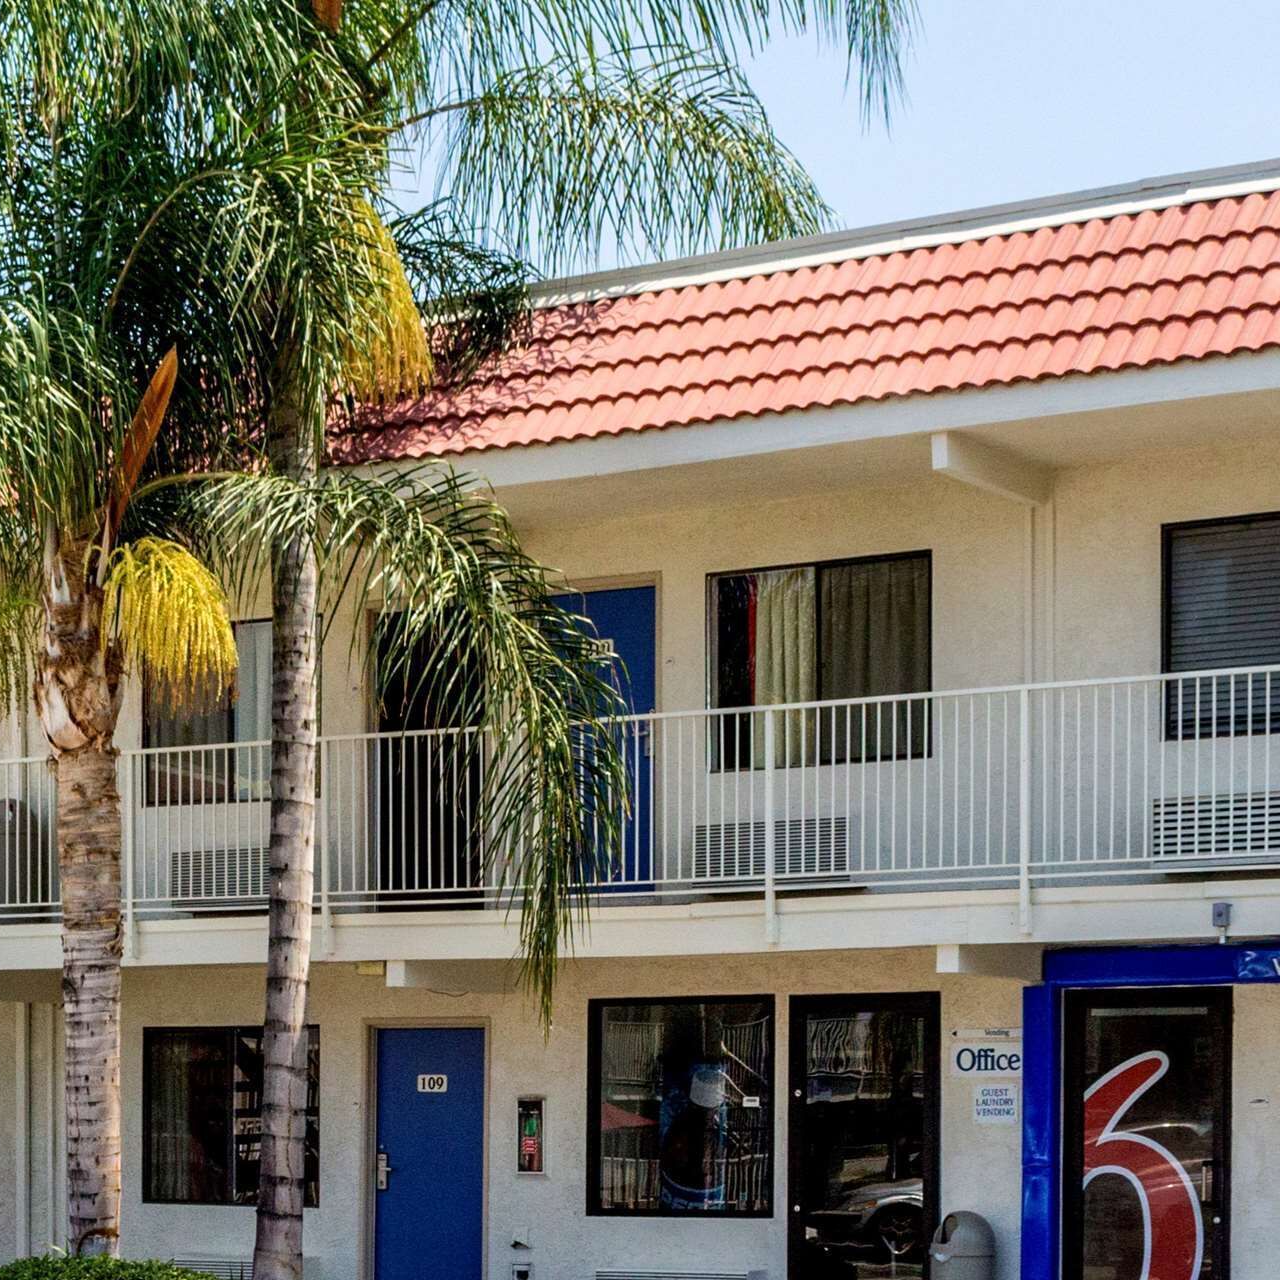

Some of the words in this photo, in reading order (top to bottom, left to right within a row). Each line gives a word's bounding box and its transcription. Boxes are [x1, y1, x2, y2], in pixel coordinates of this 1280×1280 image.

[956, 1047, 1021, 1072] Office
[421, 1076, 444, 1090] 109
[981, 1088, 1008, 1097] GUEST
[975, 1098, 1014, 1107] LAUNDRY
[975, 1107, 1015, 1117] VENDING
